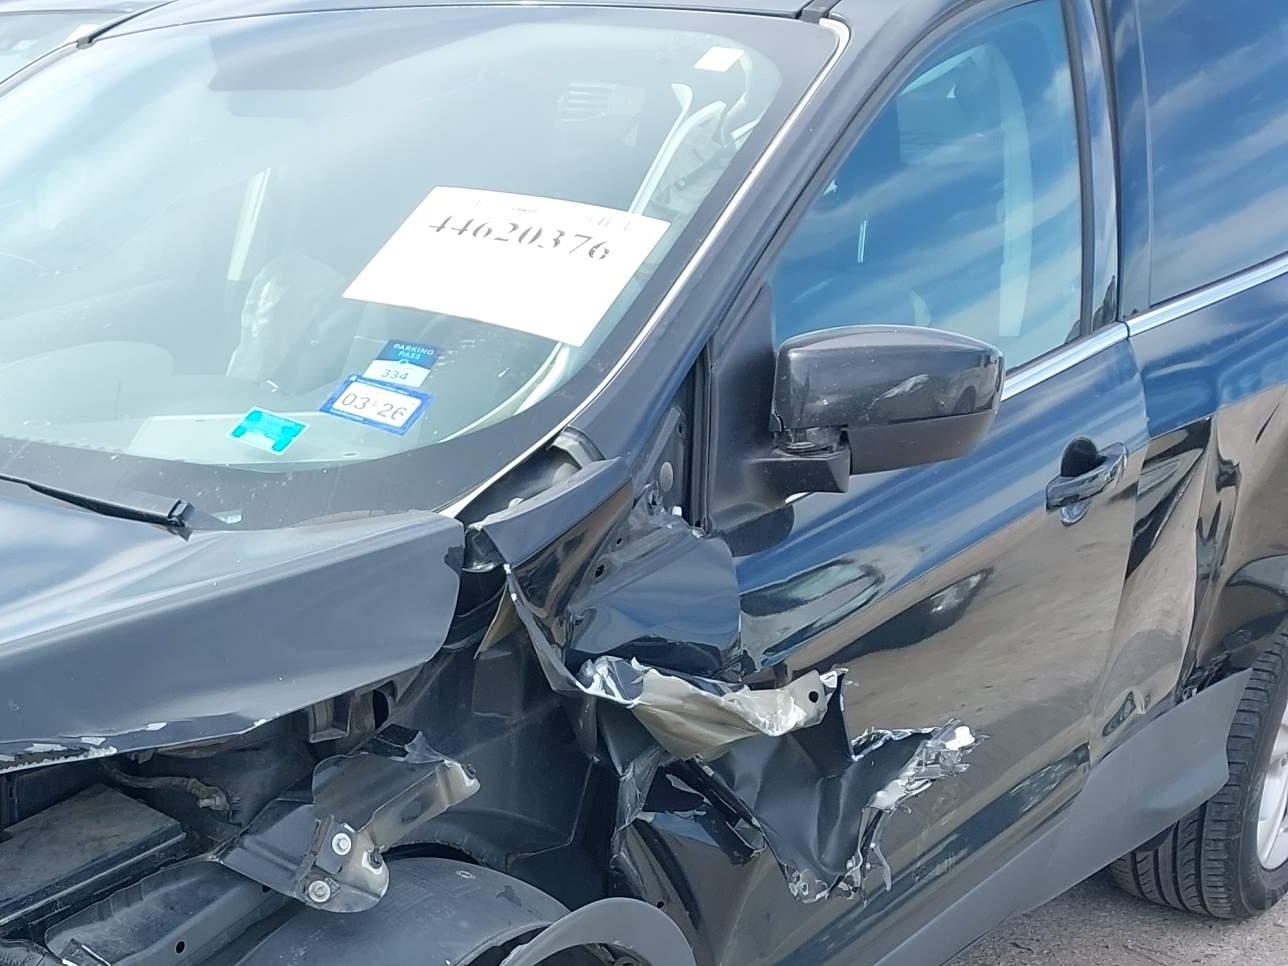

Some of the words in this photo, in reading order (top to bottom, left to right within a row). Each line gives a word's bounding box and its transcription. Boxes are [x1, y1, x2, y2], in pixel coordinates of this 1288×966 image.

[428, 215, 610, 260] 44620376
[393, 343, 434, 356] PARKING
[381, 368, 409, 380] 334
